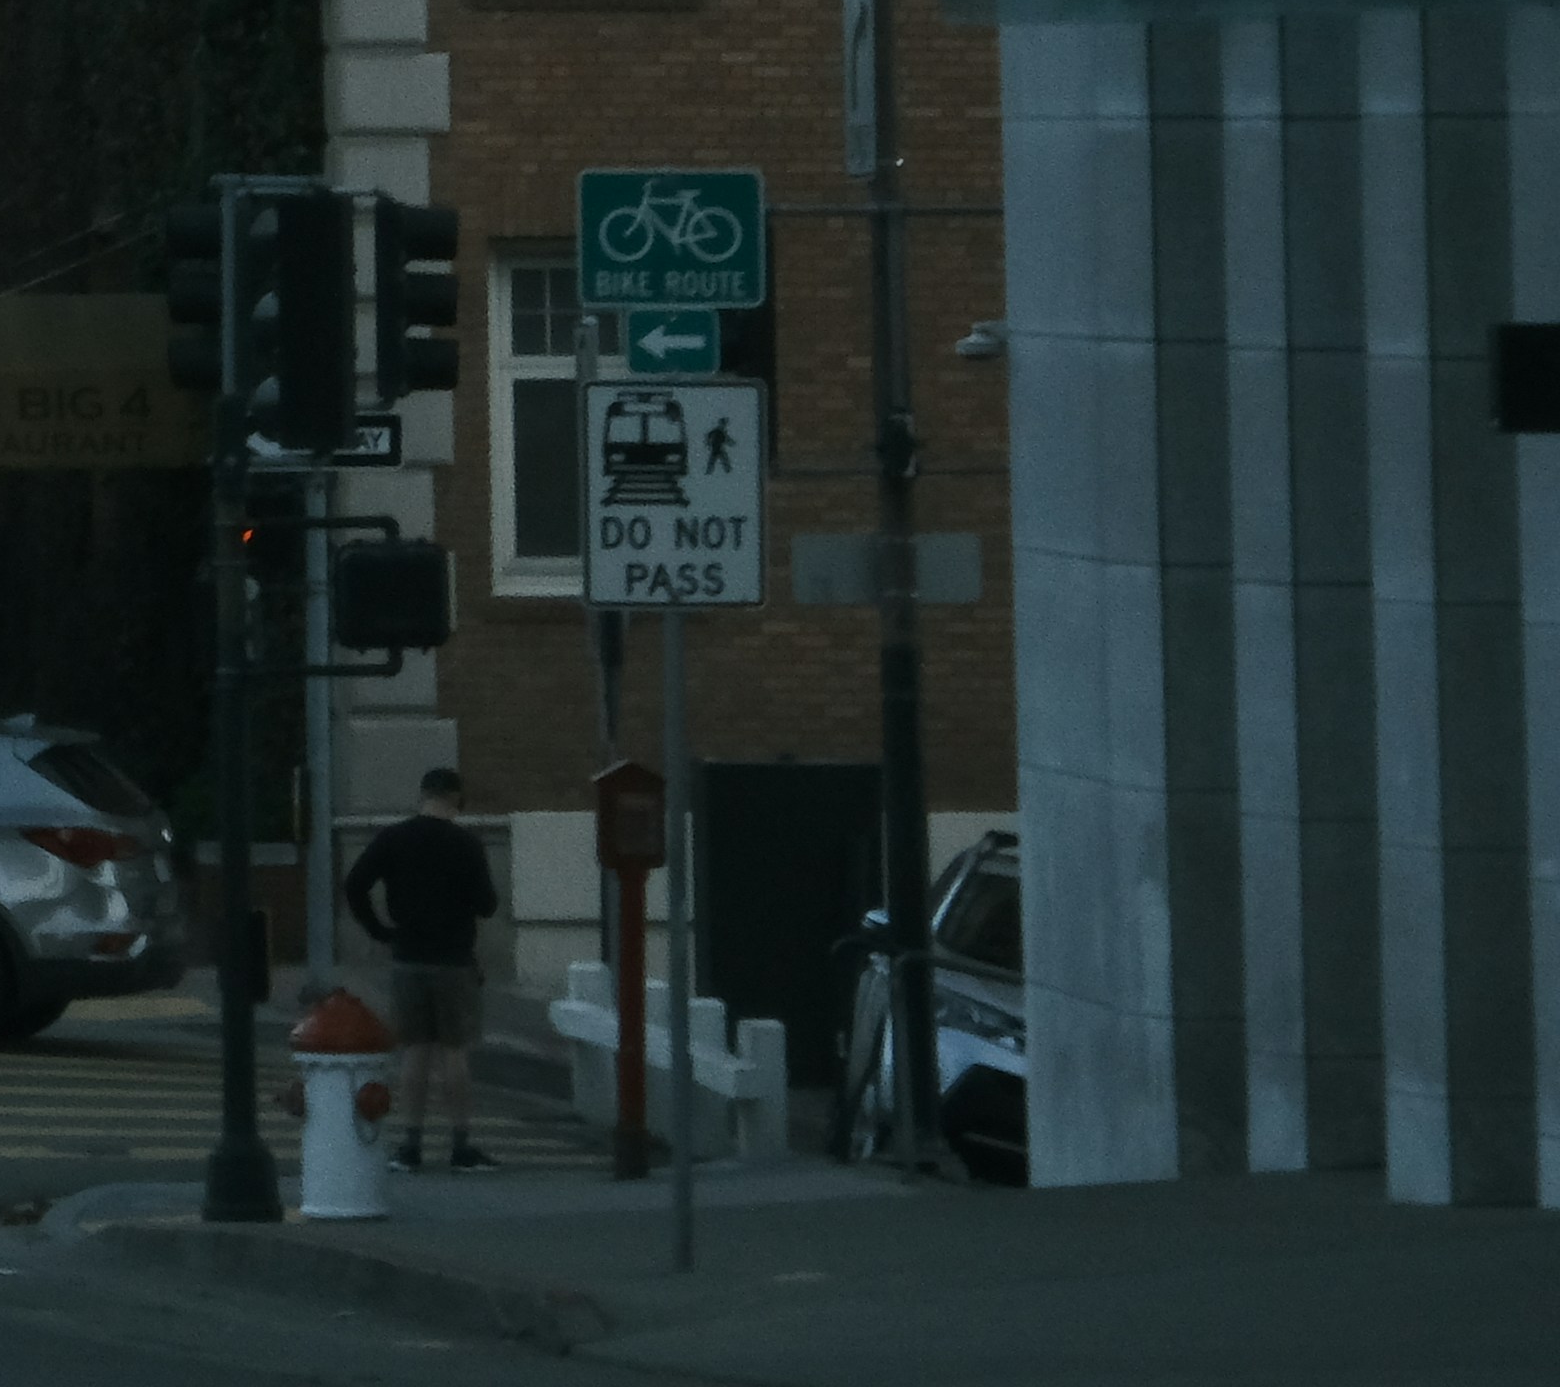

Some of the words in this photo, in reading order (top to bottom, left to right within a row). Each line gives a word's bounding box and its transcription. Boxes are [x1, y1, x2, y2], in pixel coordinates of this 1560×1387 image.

[595, 270, 651, 297] BIKE
[665, 270, 746, 297] ROUTE
[19, 386, 104, 421] BIG
[119, 385, 153, 418] 4
[600, 515, 652, 549] DO
[674, 515, 747, 549] NOT
[625, 562, 725, 596] PASS
